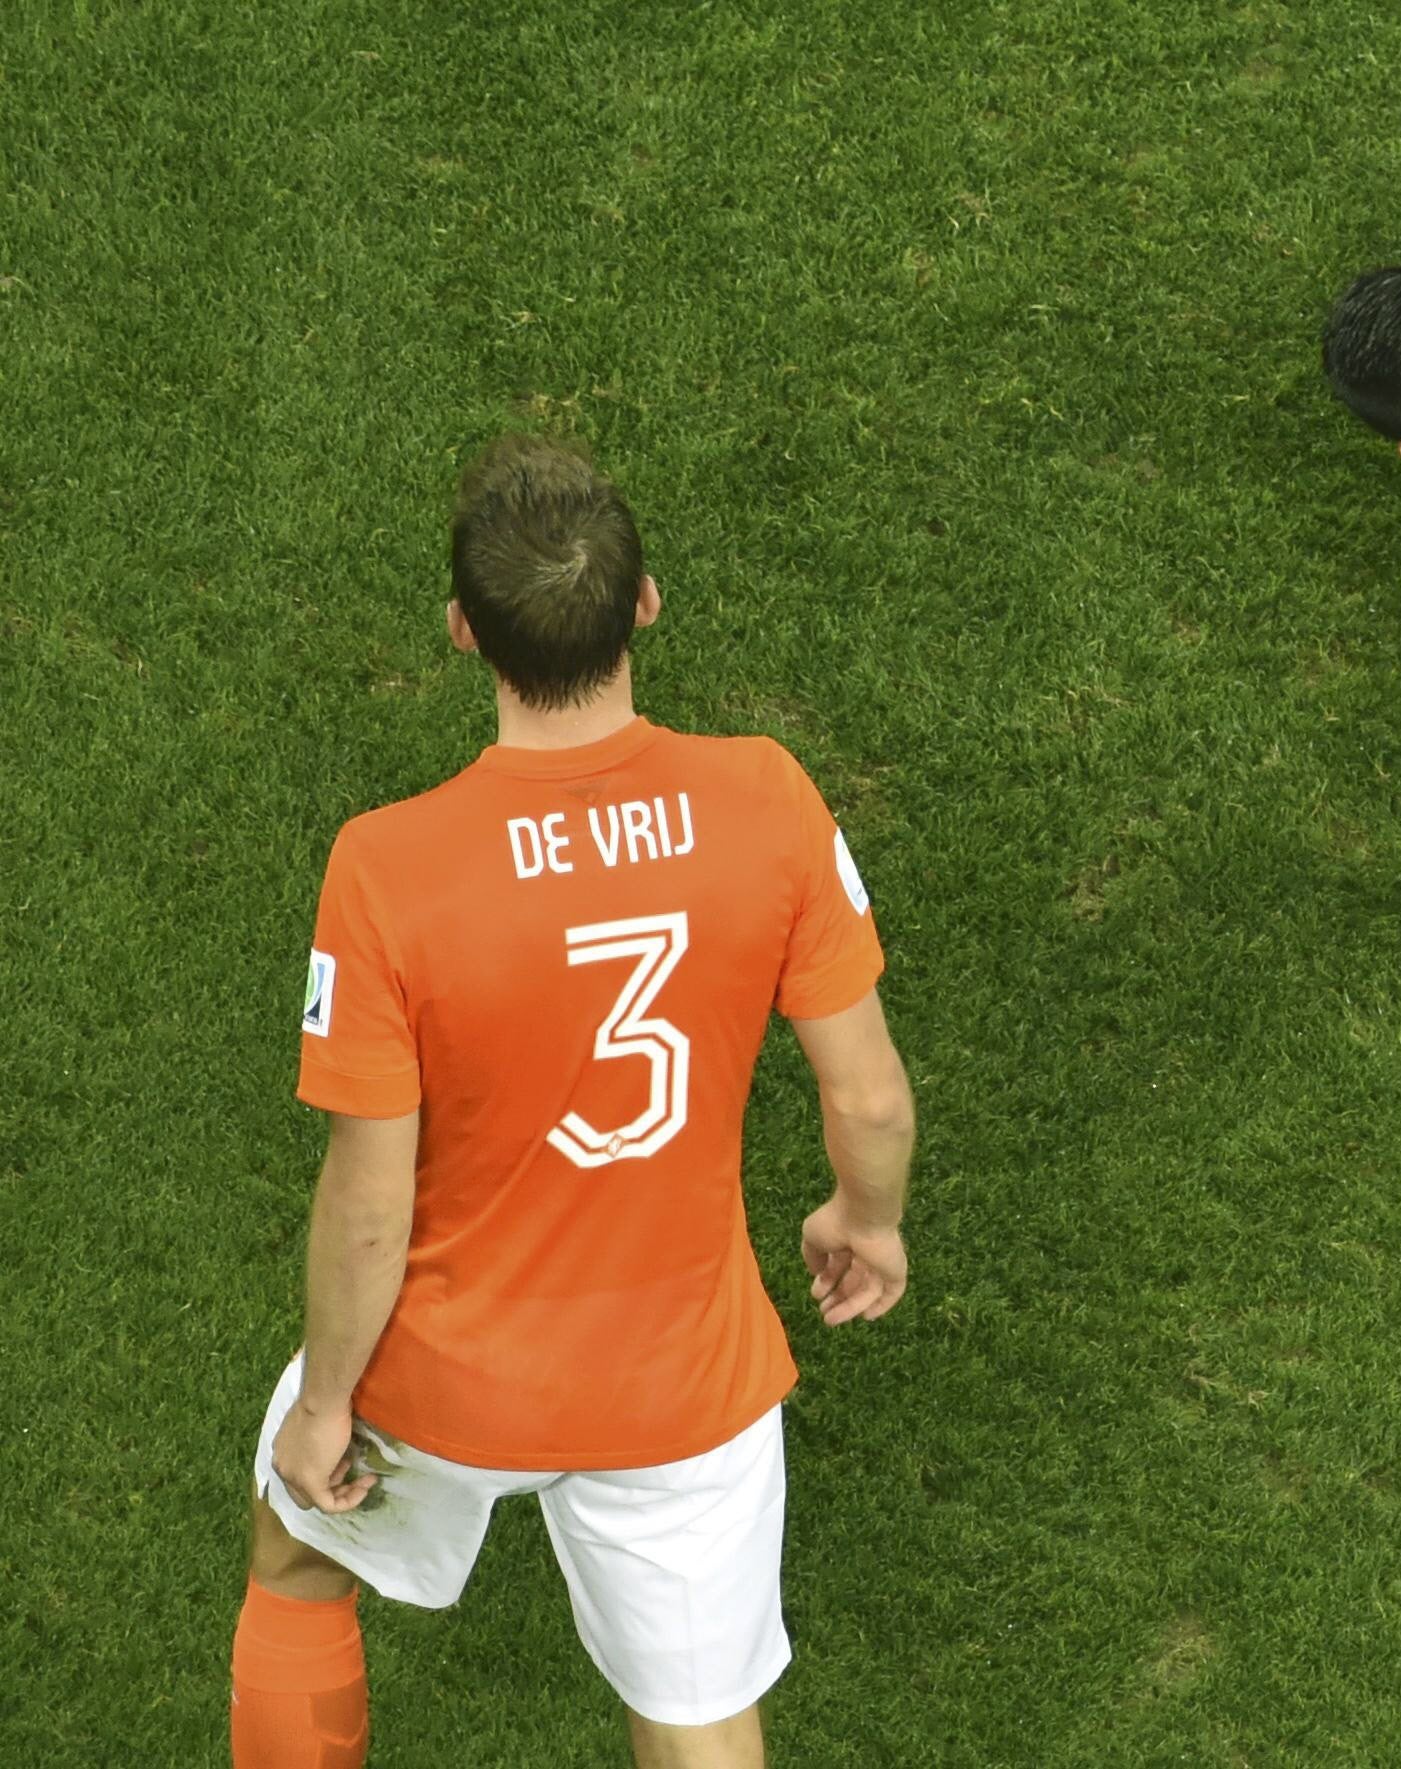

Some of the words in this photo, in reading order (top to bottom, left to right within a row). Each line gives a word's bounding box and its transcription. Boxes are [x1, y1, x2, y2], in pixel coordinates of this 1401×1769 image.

[507, 812, 574, 879] DE
[588, 792, 695, 867] VRIJ
[546, 911, 690, 1168] 3
